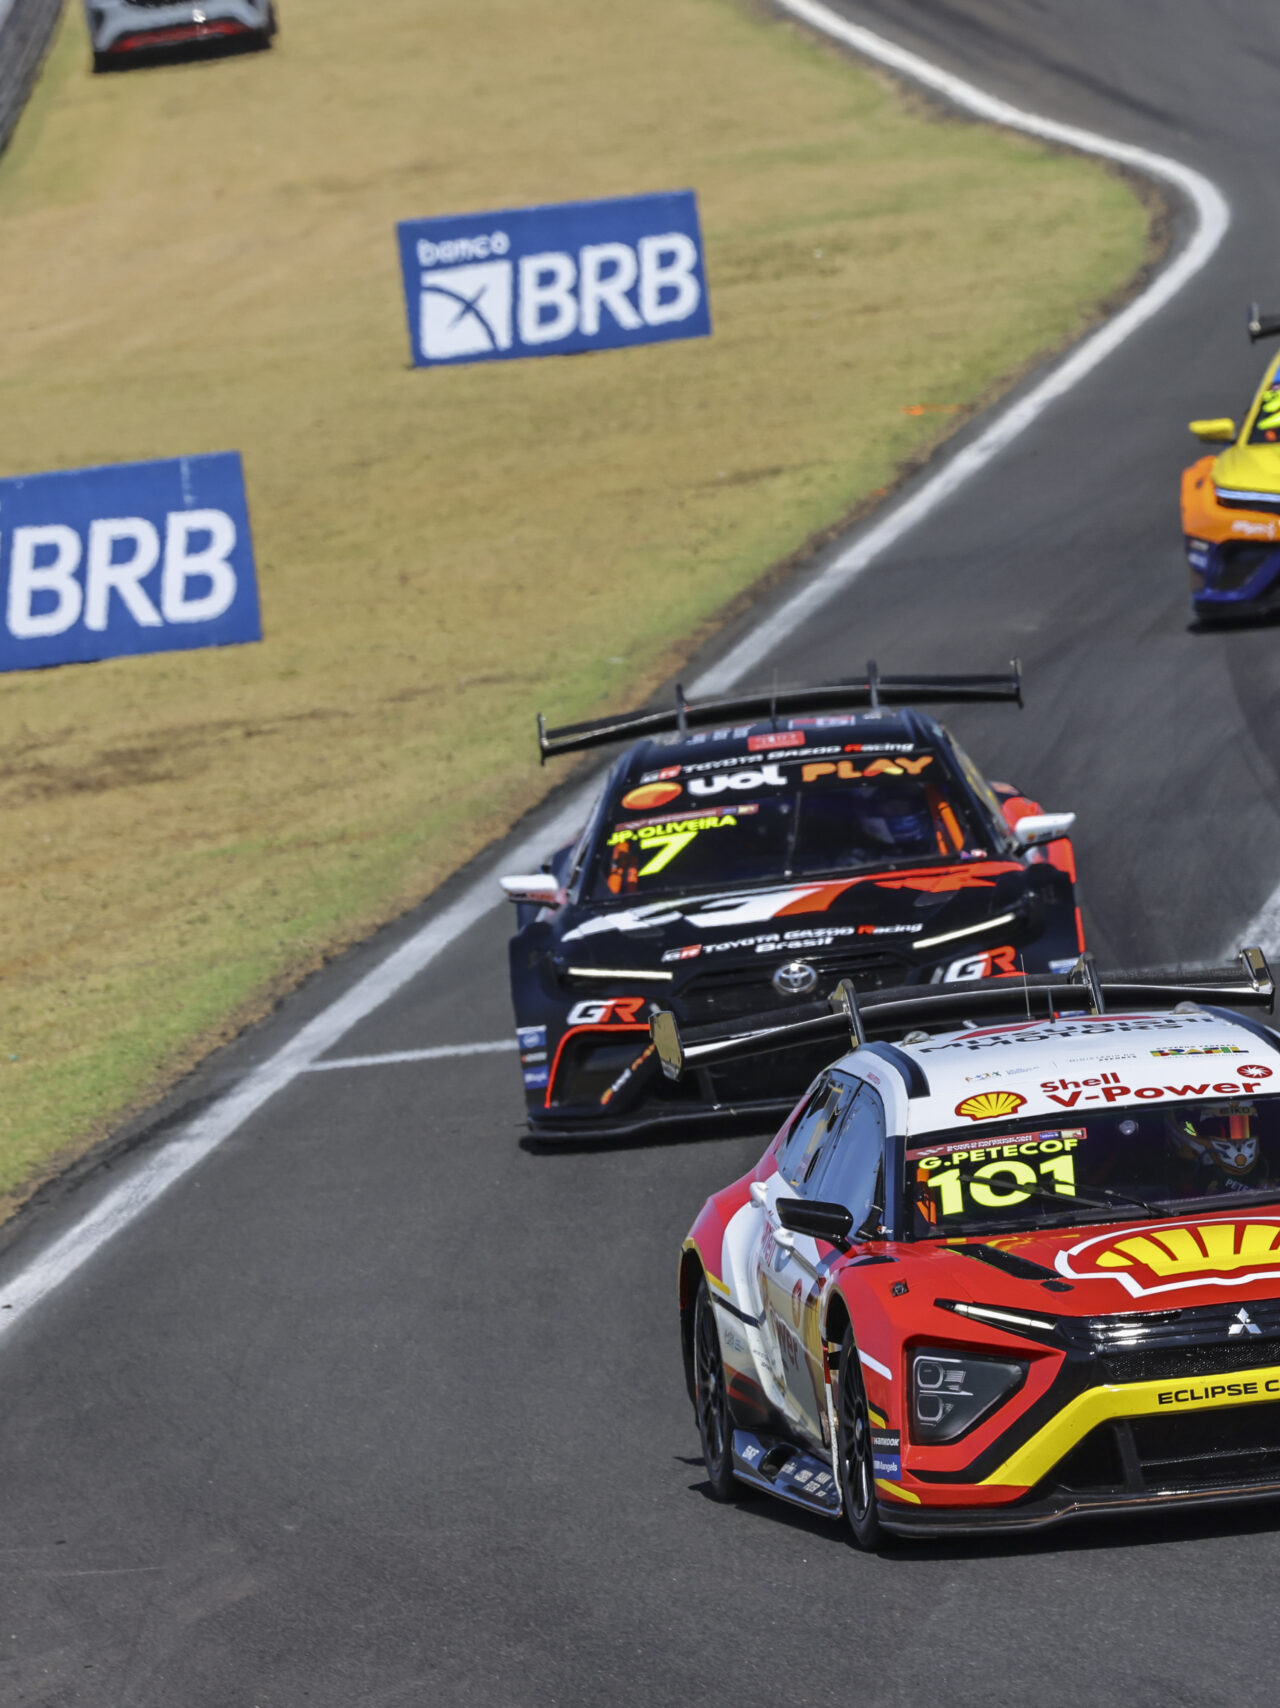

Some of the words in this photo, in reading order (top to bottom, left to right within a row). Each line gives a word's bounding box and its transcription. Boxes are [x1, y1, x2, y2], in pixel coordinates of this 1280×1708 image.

[417, 230, 511, 267] banco
[518, 232, 700, 345] BRB
[7, 508, 237, 639] BRB
[683, 754, 764, 773] TOYOTA
[767, 745, 841, 761] GAZOO
[844, 743, 914, 753] Racing
[802, 756, 933, 783] PLAY
[607, 814, 738, 846] JP.OLIVEIRA
[638, 830, 698, 877] 7
[703, 933, 780, 953] TOYOTA
[784, 926, 855, 941] GAZOO
[857, 923, 923, 935] Racing
[755, 937, 834, 953] Brasil
[943, 945, 1017, 984] GR
[566, 997, 645, 1025] GR
[1040, 1072, 1121, 1093] Shell
[1045, 1082, 1261, 1108] V-Power
[918, 1138, 1079, 1170] G.PETECOF
[927, 1154, 1076, 1216] 101
[1158, 1382, 1258, 1405] ECLIPSE
